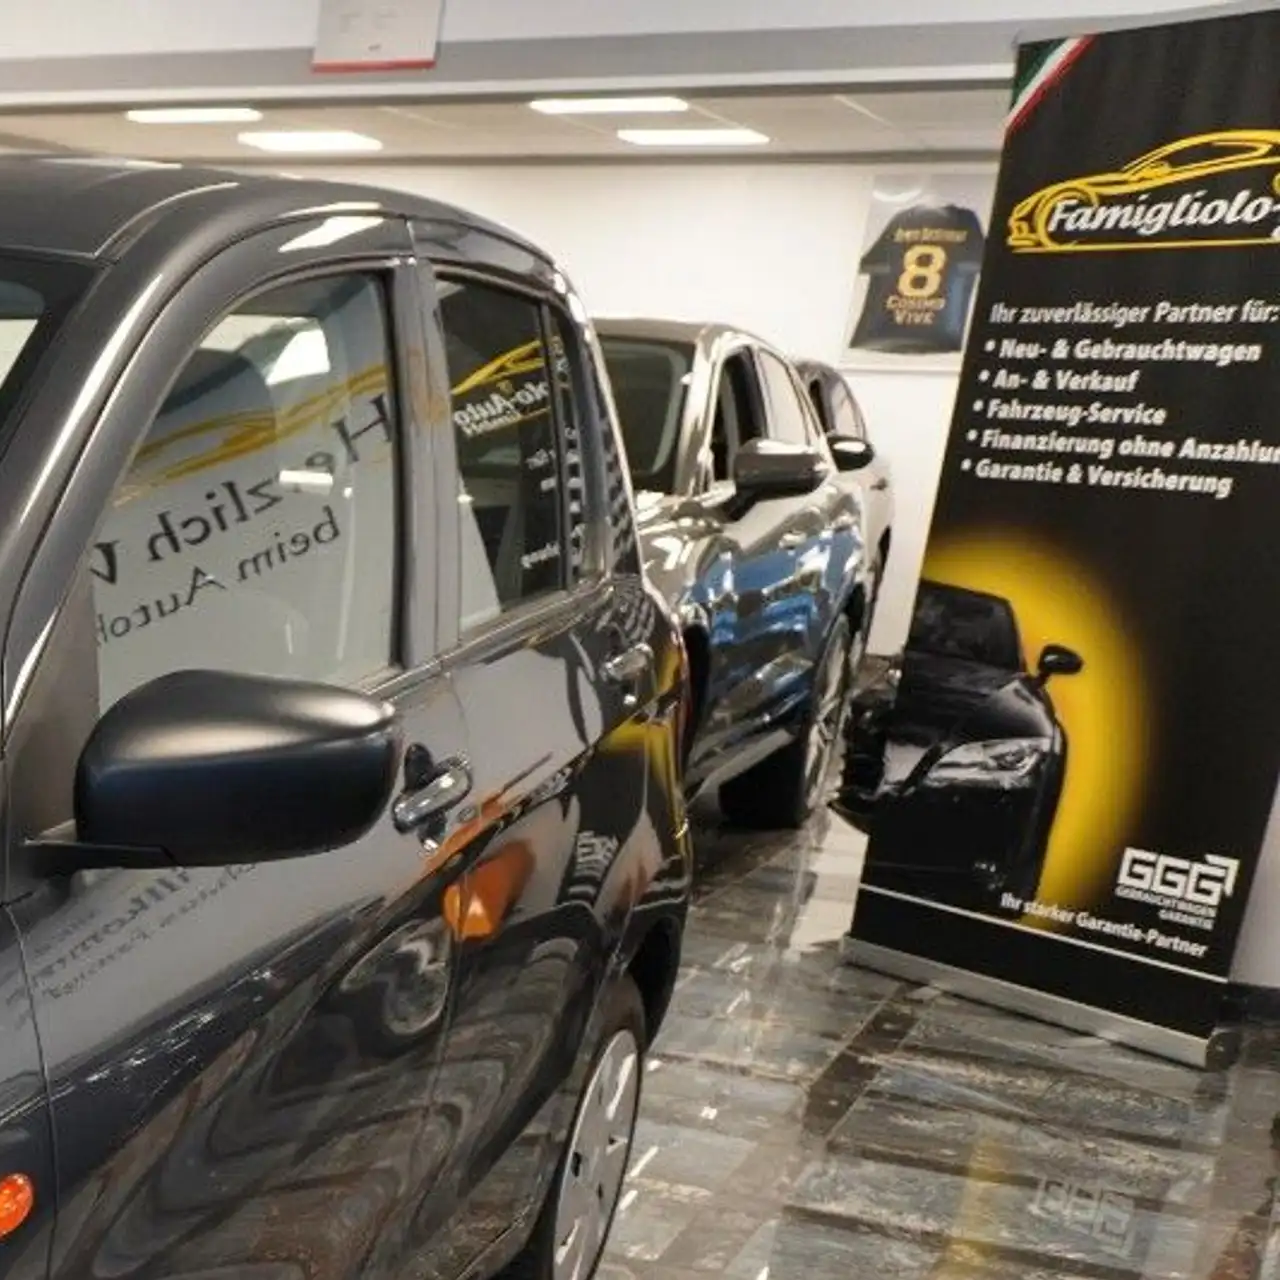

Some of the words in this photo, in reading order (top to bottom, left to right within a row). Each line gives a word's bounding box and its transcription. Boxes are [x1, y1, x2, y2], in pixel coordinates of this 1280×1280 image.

[1047, 189, 1280, 242] Famigliolo-
[897, 244, 947, 297] 8
[990, 302, 1016, 323] Ihr
[1017, 302, 1151, 328] zuverlässiger
[1153, 301, 1238, 323] Partner
[1240, 299, 1280, 323] für:
[998, 338, 1047, 359] Neu-
[1050, 338, 1070, 360] &
[1073, 338, 1262, 367] Gebrauchtwagen
[992, 369, 1029, 389] An-
[1031, 369, 1051, 390] &
[1055, 369, 1140, 392] Verkauf
[986, 398, 1168, 427] Fahrzeug-Service
[980, 428, 1116, 460] Finanzierung
[1118, 434, 1176, 458] ohne
[975, 458, 1063, 483] Garantie
[1066, 463, 1083, 484] &
[1087, 465, 1233, 499] Versicherung
[1118, 847, 1230, 906] GGG
[1001, 892, 1021, 909] Ihr
[1023, 898, 1076, 925] starker
[1076, 911, 1209, 957] Garantie-Partner
